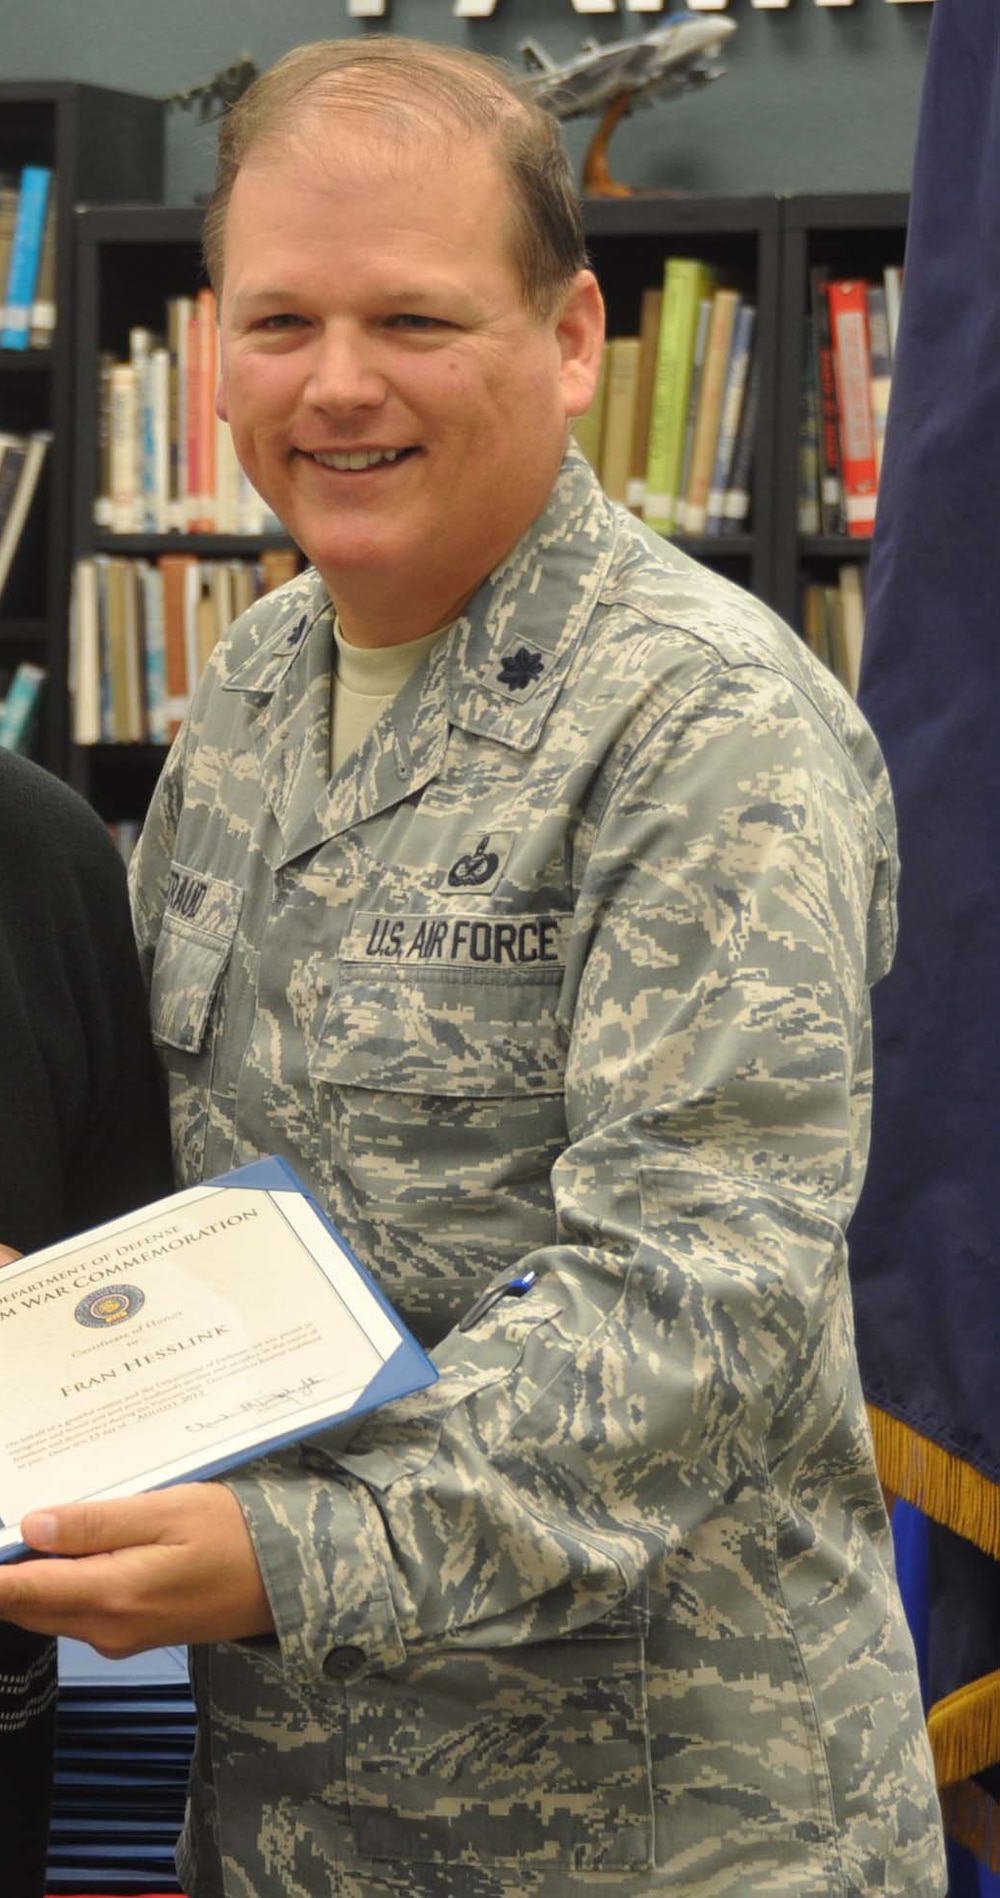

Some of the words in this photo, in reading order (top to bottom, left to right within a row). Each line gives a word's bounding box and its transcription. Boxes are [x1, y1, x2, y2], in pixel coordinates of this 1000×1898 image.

[366, 918, 404, 957] U.S.
[406, 919, 449, 959] AIR
[451, 917, 558, 963] FORCE
[21, 1285, 69, 1310] WAR
[72, 1207, 260, 1288] COMMEMORATION
[91, 1253, 112, 1268] OF
[116, 1225, 181, 1257] DEFENSE
[60, 1370, 118, 1398] FRAN
[124, 1323, 231, 1373] HESSLINK
